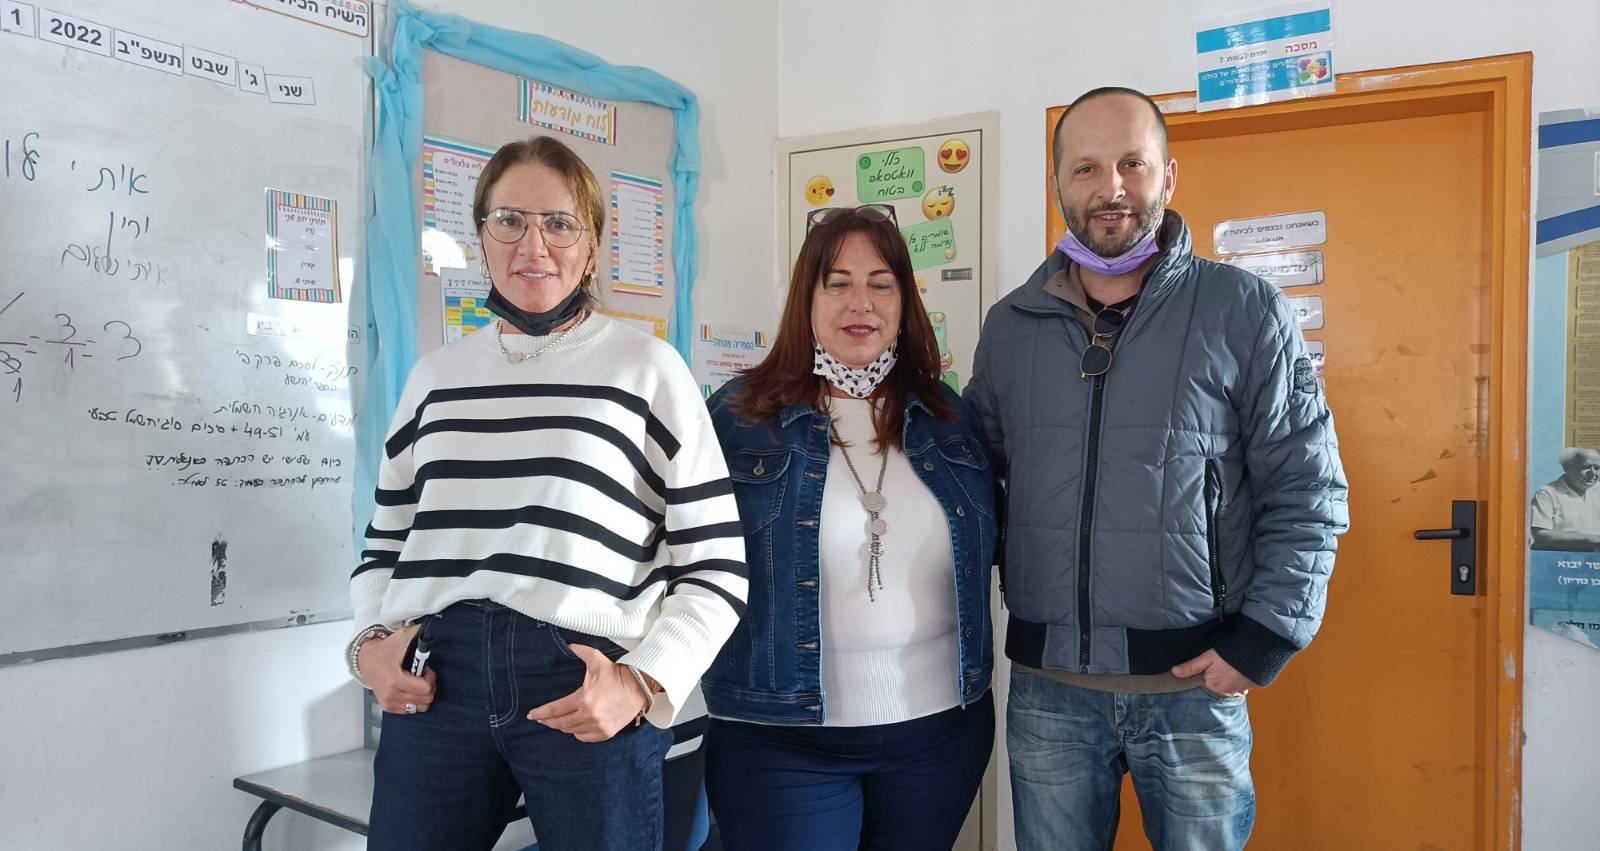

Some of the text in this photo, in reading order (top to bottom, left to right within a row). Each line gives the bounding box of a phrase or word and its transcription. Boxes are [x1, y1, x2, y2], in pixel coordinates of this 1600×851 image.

[11, 9, 21, 26] 1
[325, 6, 366, 27] השיח
[50, 18, 102, 46] 2022
[118, 39, 181, 68] תשפ"ב
[1285, 41, 1318, 54] מסכה
[191, 56, 228, 76] שבט
[279, 84, 302, 98] שני
[587, 114, 608, 131] לוח
[877, 186, 905, 197] בטוח
[103, 320, 142, 362] 3
[254, 354, 281, 369] פרק
[243, 422, 283, 439] 49-51
[262, 454, 274, 464] יש
